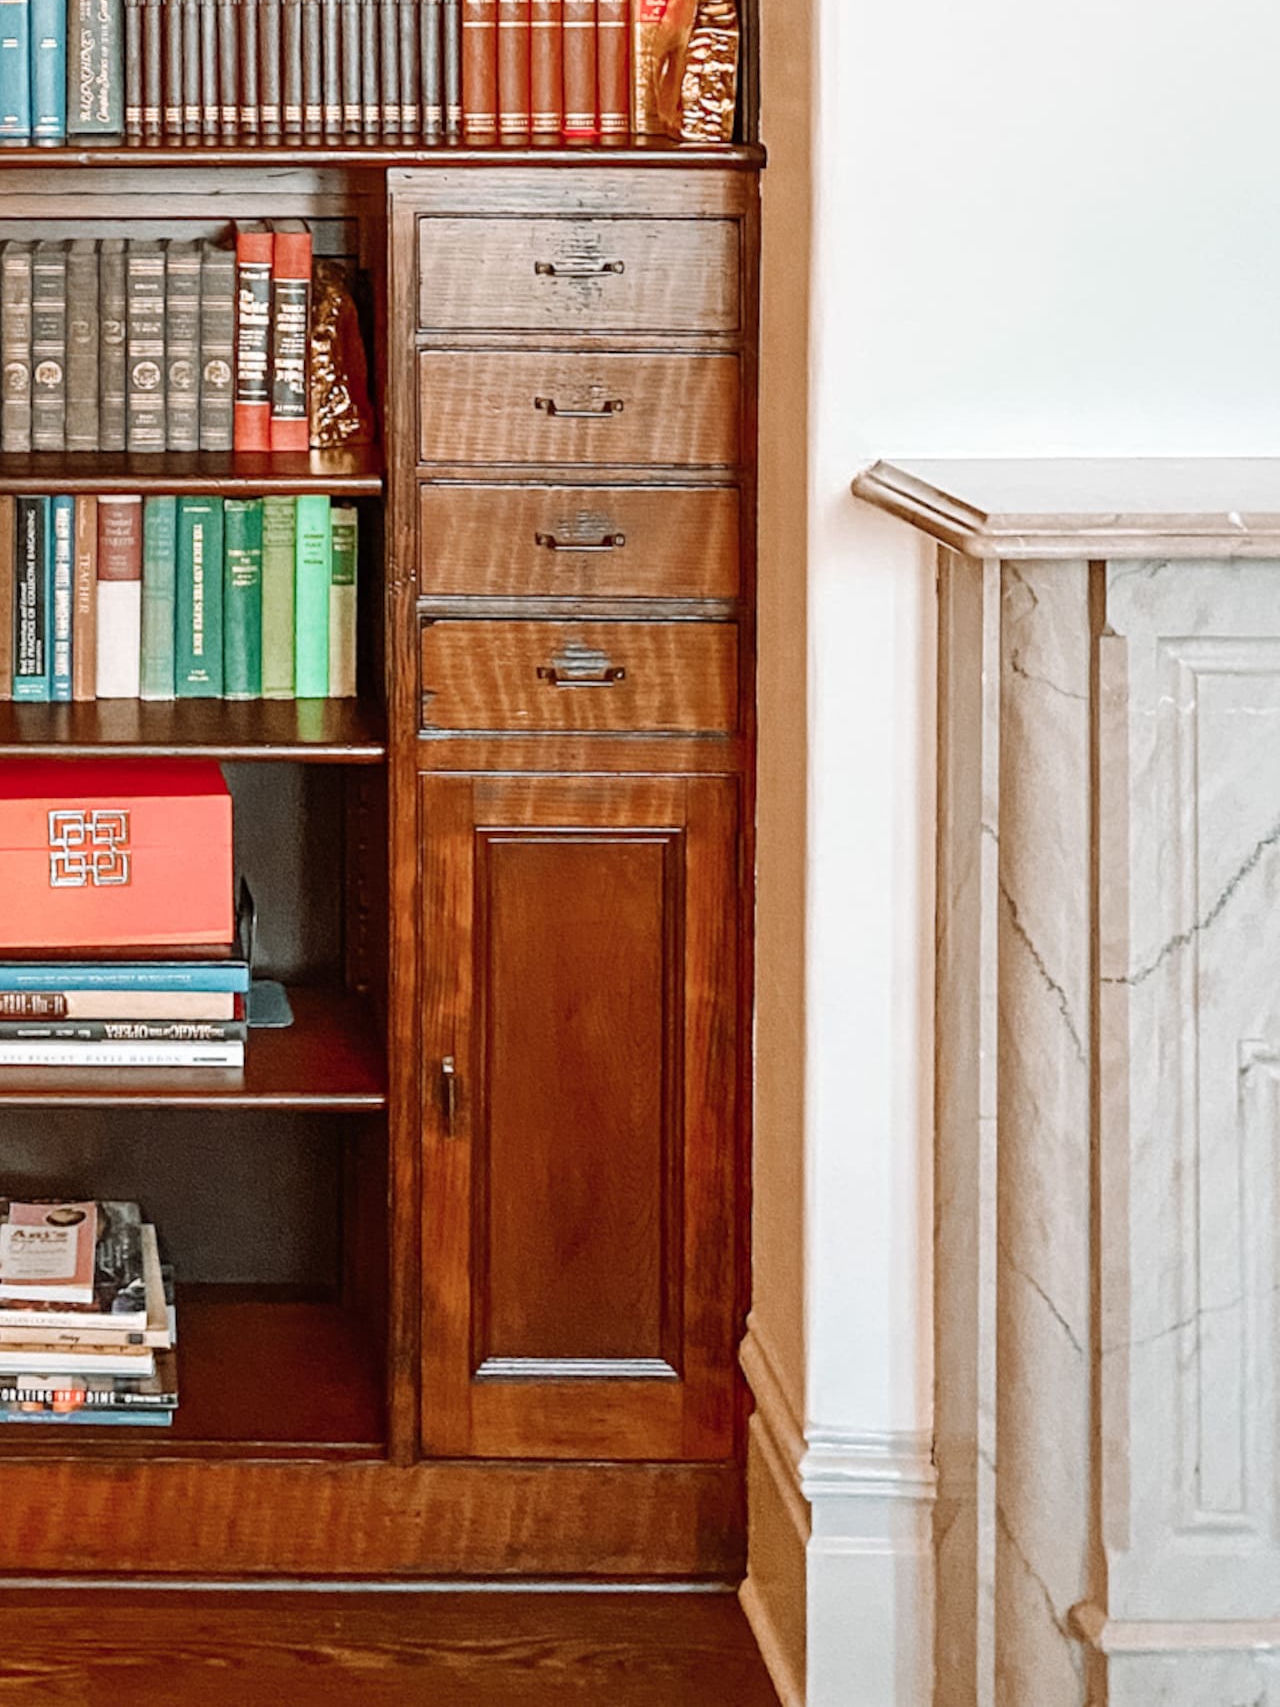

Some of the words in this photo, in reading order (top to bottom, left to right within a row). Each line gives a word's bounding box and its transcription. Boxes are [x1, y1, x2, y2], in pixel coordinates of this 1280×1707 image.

[100, 24, 108, 44] THE
[79, 28, 95, 122] BALANCHINE'S
[27, 510, 36, 560] BARGAINING
[193, 524, 203, 539] THE
[193, 542, 203, 563] RICH
[193, 565, 203, 582] AND
[27, 562, 35, 607] COLLECTIVE
[79, 553, 91, 613] TEACHER
[27, 608, 35, 620] OF
[27, 621, 35, 657] PRACTICE
[27, 660, 35, 675] THE
[105, 1024, 148, 1039] OPERA
[170, 1025, 211, 1038] MAGIC
[86, 1390, 116, 1403] DIME
